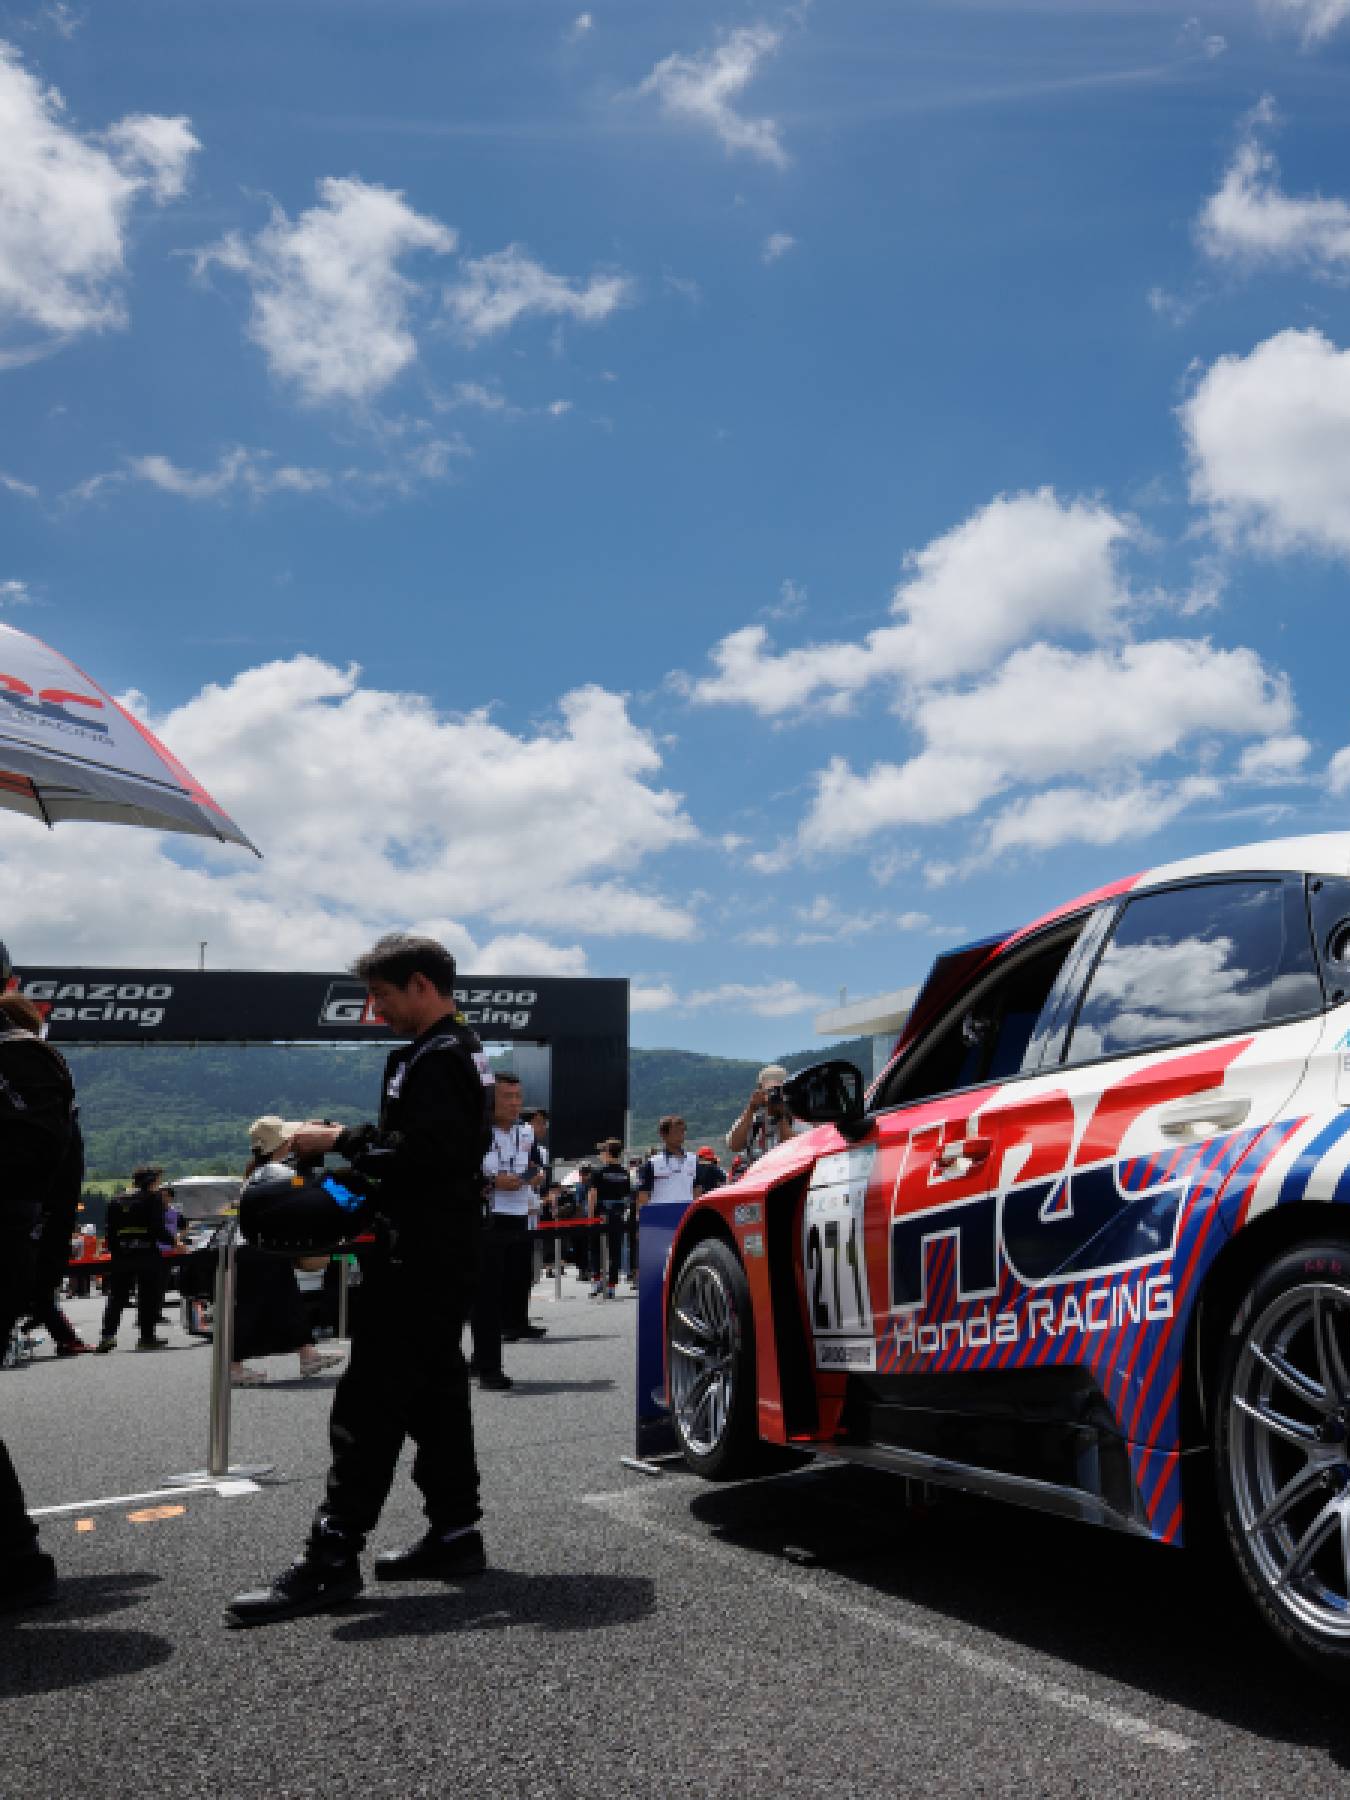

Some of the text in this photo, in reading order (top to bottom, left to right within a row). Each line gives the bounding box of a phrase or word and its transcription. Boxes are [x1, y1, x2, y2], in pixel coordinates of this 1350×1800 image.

[23, 980, 175, 1000] GAZOO
[452, 988, 539, 1006] AZOO
[463, 1007, 532, 1030] cing
[807, 1217, 869, 1331] 271
[893, 1274, 1174, 1357] Honda RACING
